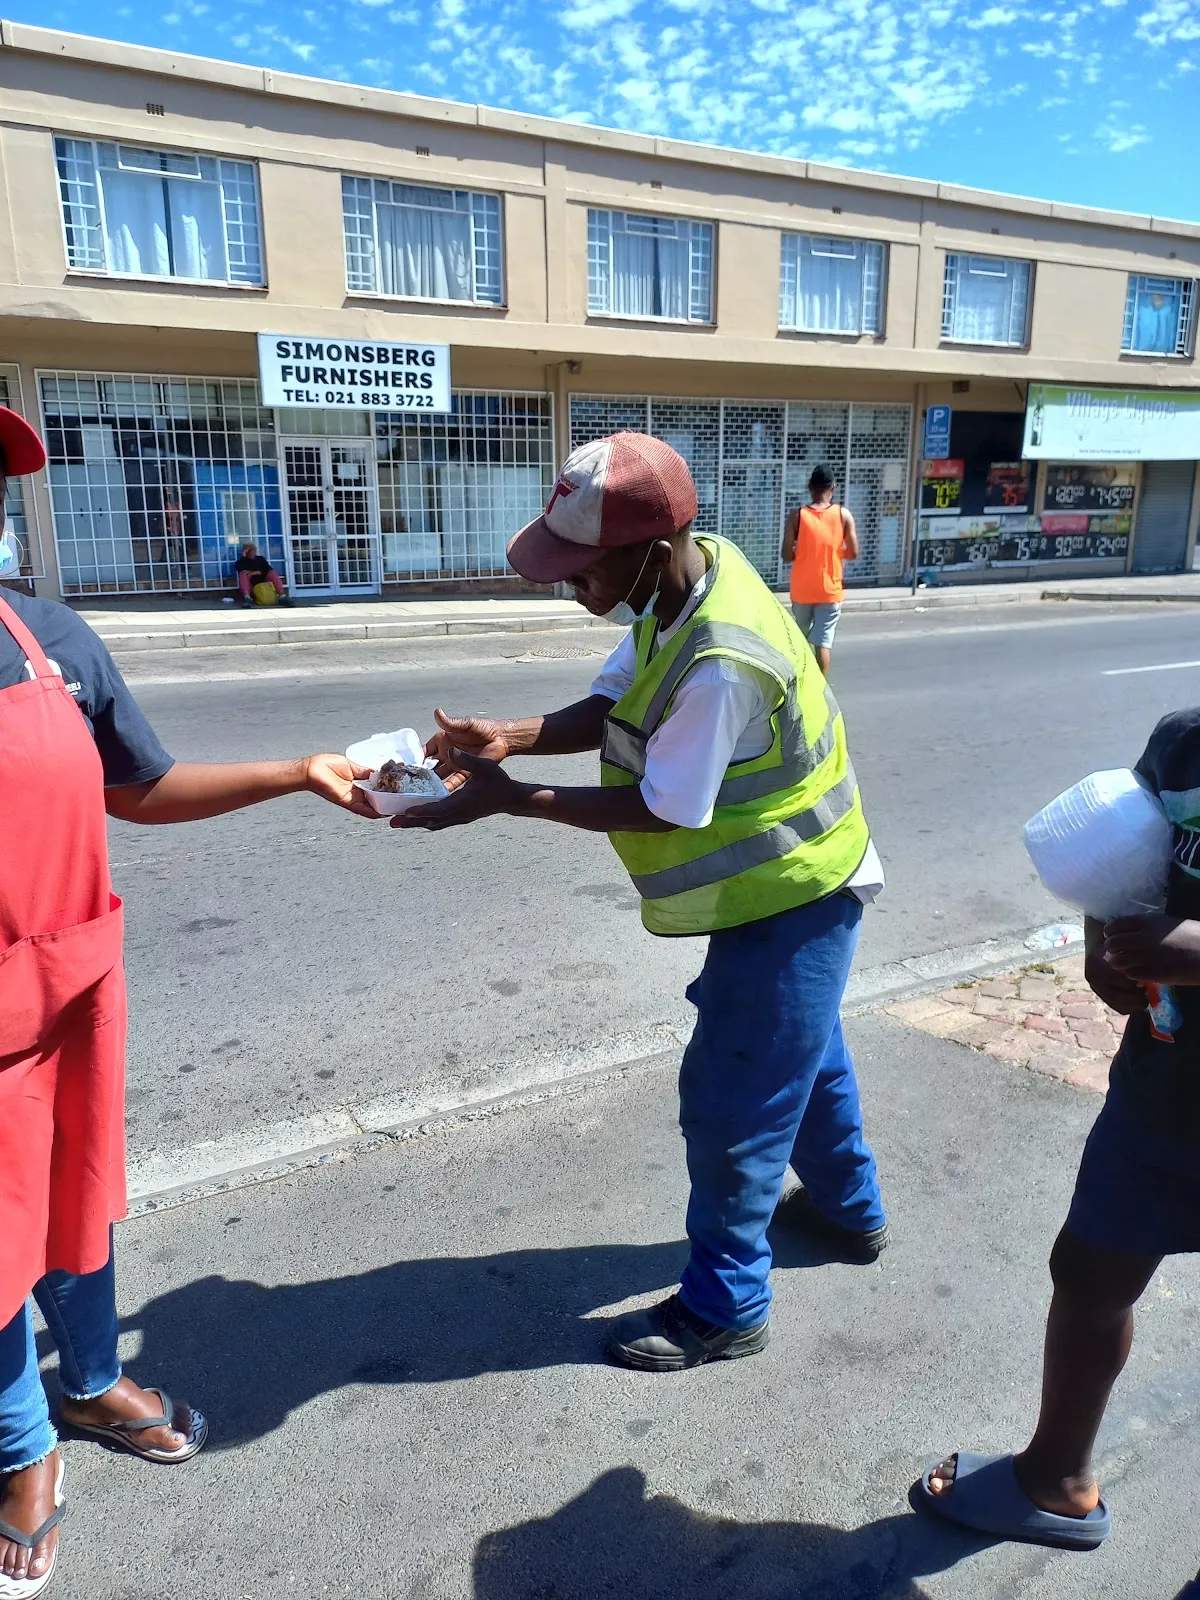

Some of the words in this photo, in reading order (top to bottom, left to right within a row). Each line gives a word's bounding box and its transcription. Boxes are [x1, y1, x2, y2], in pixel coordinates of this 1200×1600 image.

[276, 341, 436, 367] SIMONSBERG
[281, 365, 433, 389] FURNISHERS
[283, 389, 320, 403] TEL:
[325, 391, 356, 404] 021
[361, 393, 391, 405] 883
[395, 394, 435, 407] 3722
[933, 409, 945, 424] P
